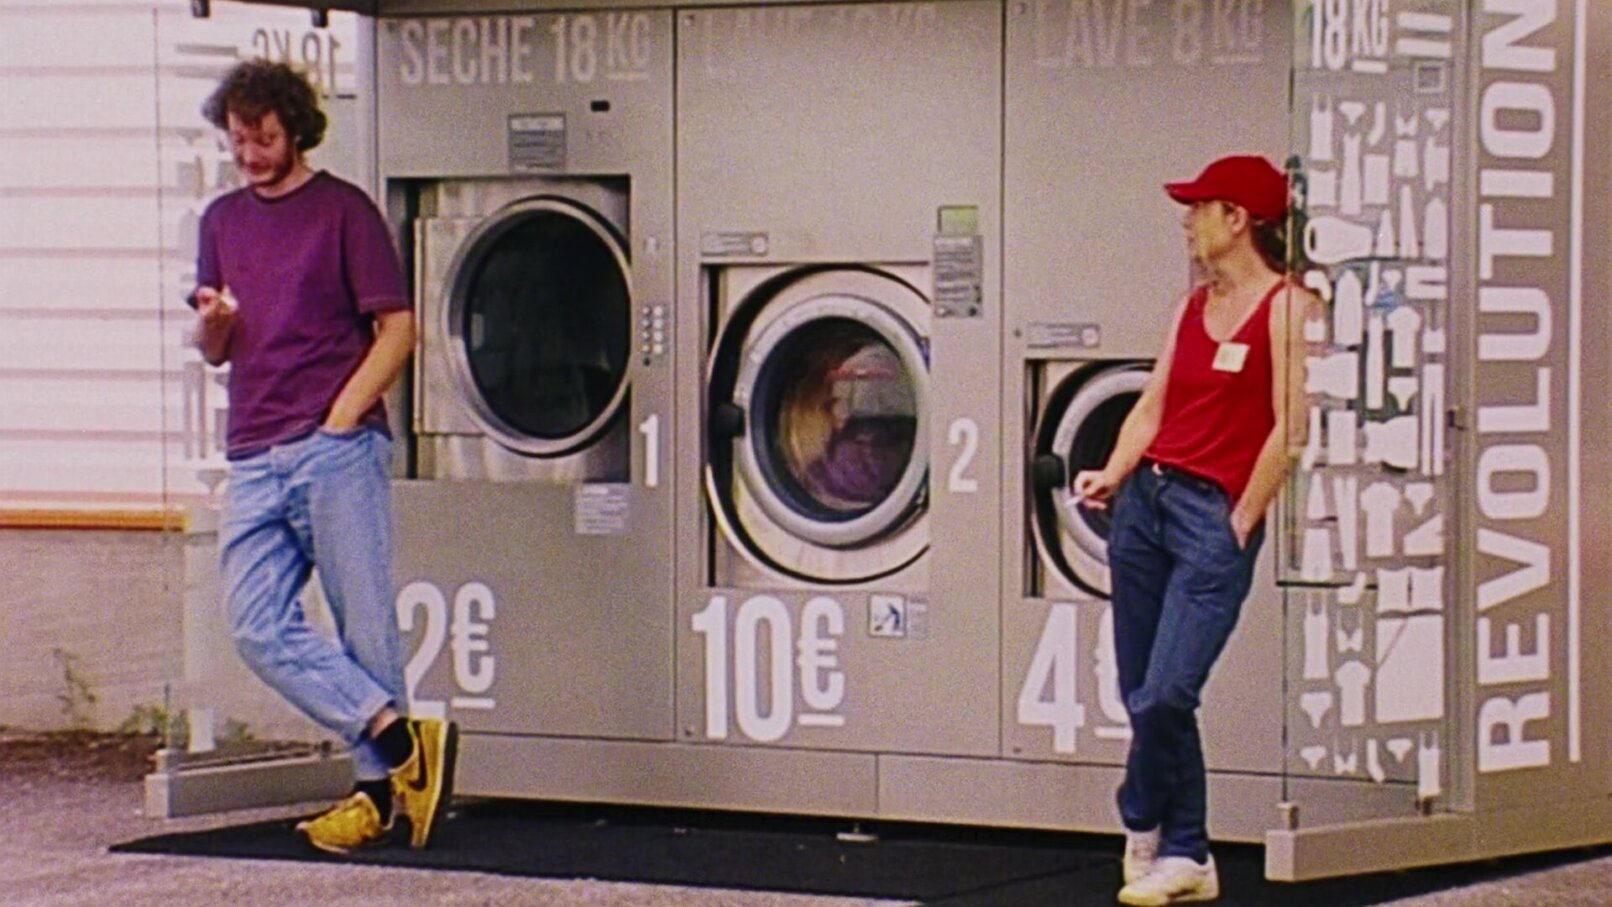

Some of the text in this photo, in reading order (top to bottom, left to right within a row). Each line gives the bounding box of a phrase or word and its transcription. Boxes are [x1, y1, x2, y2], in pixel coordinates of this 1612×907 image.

[401, 17, 535, 84] SECHE
[552, 15, 597, 83] 18
[606, 12, 650, 66] KG
[1034, 0, 1263, 66] LAVE 8 KG
[1476, 0, 1557, 773] REVOLUTION
[640, 414, 658, 487] 1
[949, 418, 978, 493] 2
[397, 582, 495, 718] 2€
[692, 595, 844, 741] 10€
